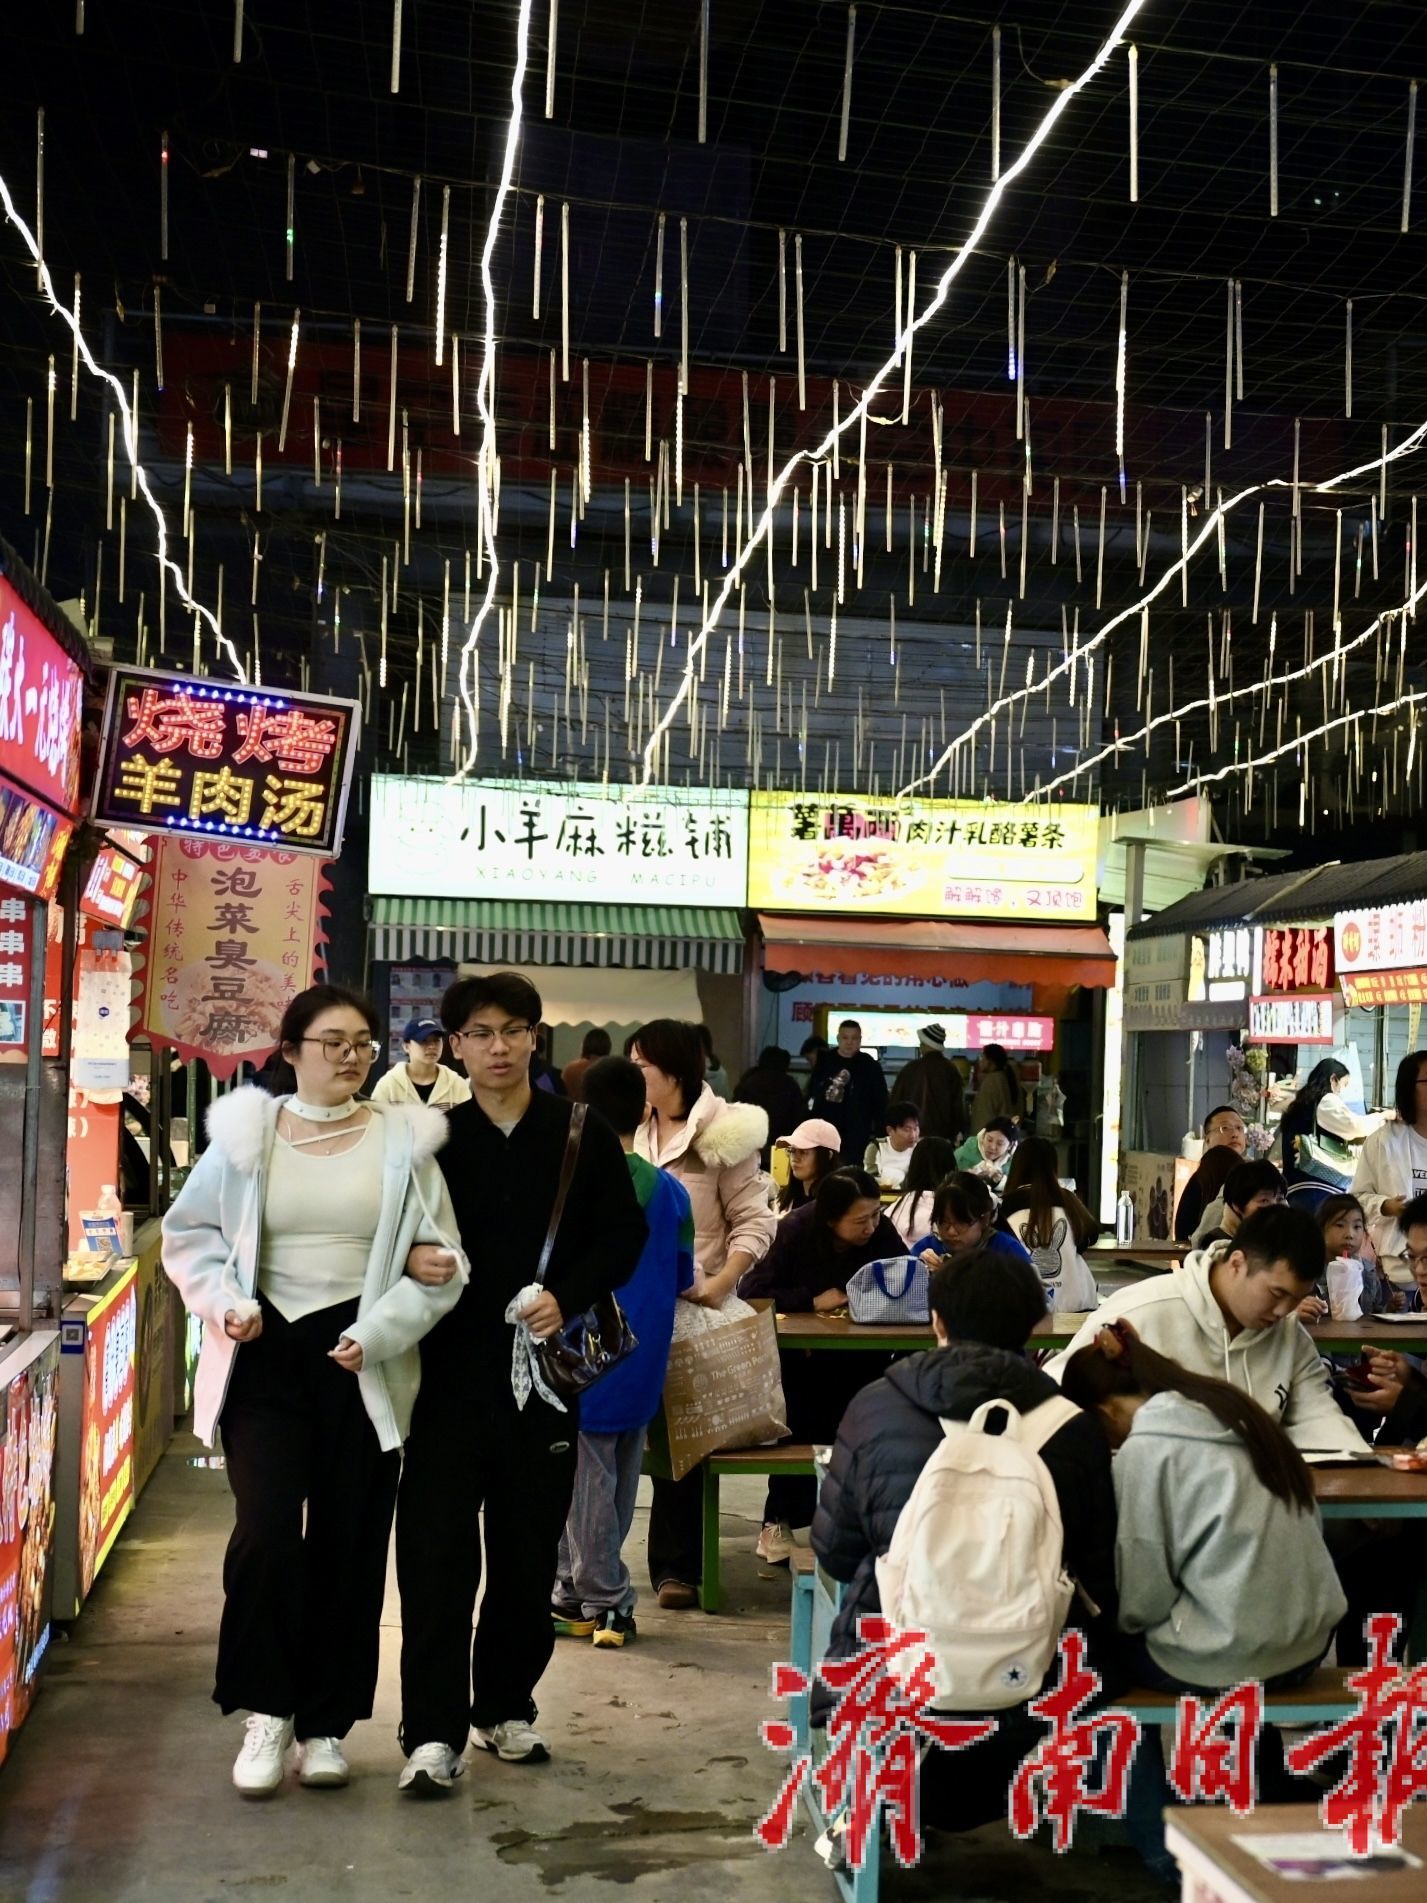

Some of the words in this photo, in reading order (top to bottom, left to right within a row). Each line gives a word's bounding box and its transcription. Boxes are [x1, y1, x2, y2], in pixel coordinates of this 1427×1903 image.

[122, 689, 335, 773] 烧烤
[114, 754, 324, 836] 羊肉汤
[906, 819, 1065, 849] 肉汁乳酪薯条
[477, 867, 598, 882] XIAOYANG
[160, 868, 188, 1011] 中华传统名吃
[199, 867, 262, 1044] 泡菜臭豆腐
